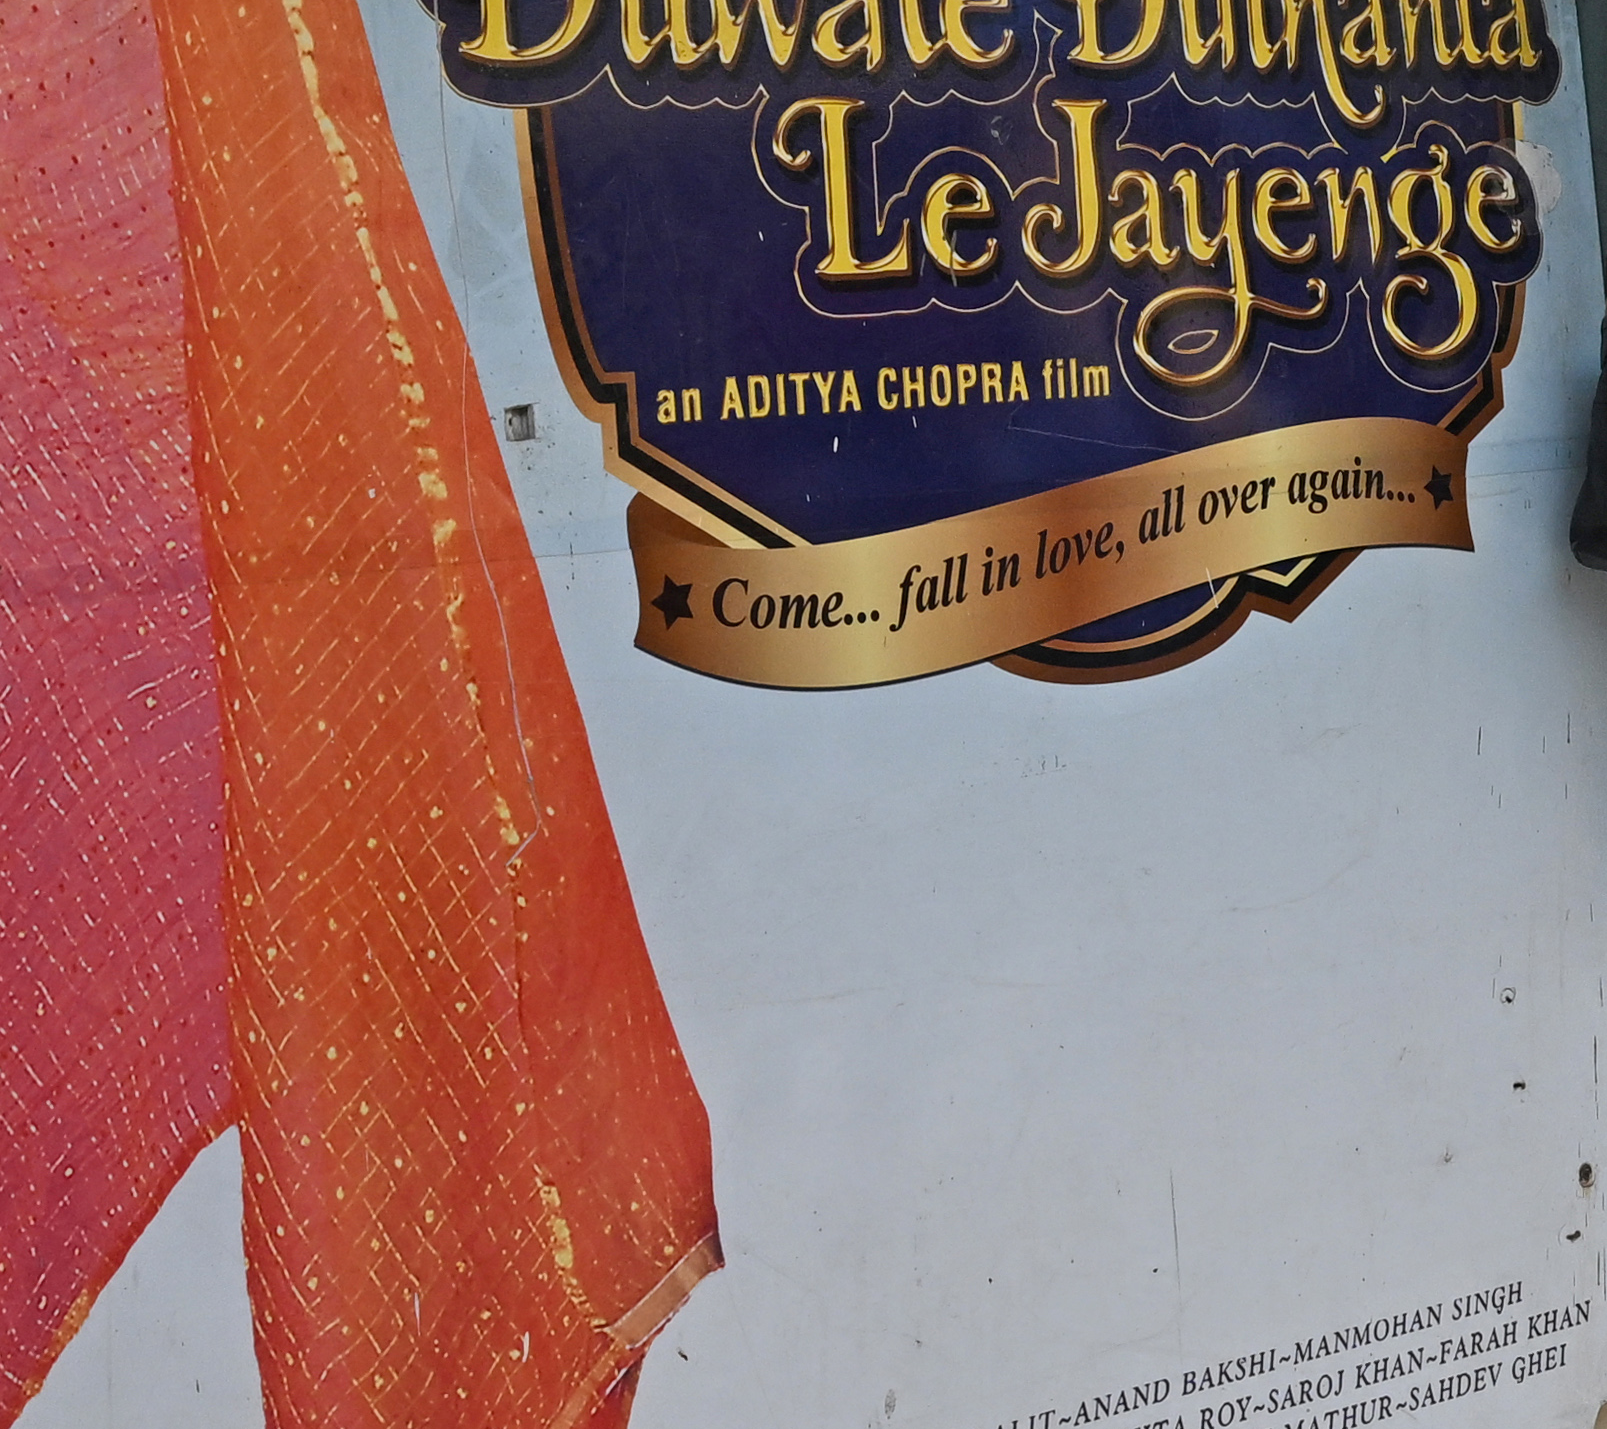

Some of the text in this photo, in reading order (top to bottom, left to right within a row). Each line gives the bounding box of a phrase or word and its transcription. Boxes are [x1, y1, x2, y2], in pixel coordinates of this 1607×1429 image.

[773, 96, 1526, 381] Le Jayenge
[656, 357, 1111, 424] an ADITYA CHOPRA film
[712, 456, 1416, 633] Come... fall in love, all over again...
[1451, 1280, 1524, 1323] SINGH
[1527, 1299, 1592, 1341] KHAN
[1511, 1343, 1568, 1385] GHEI
